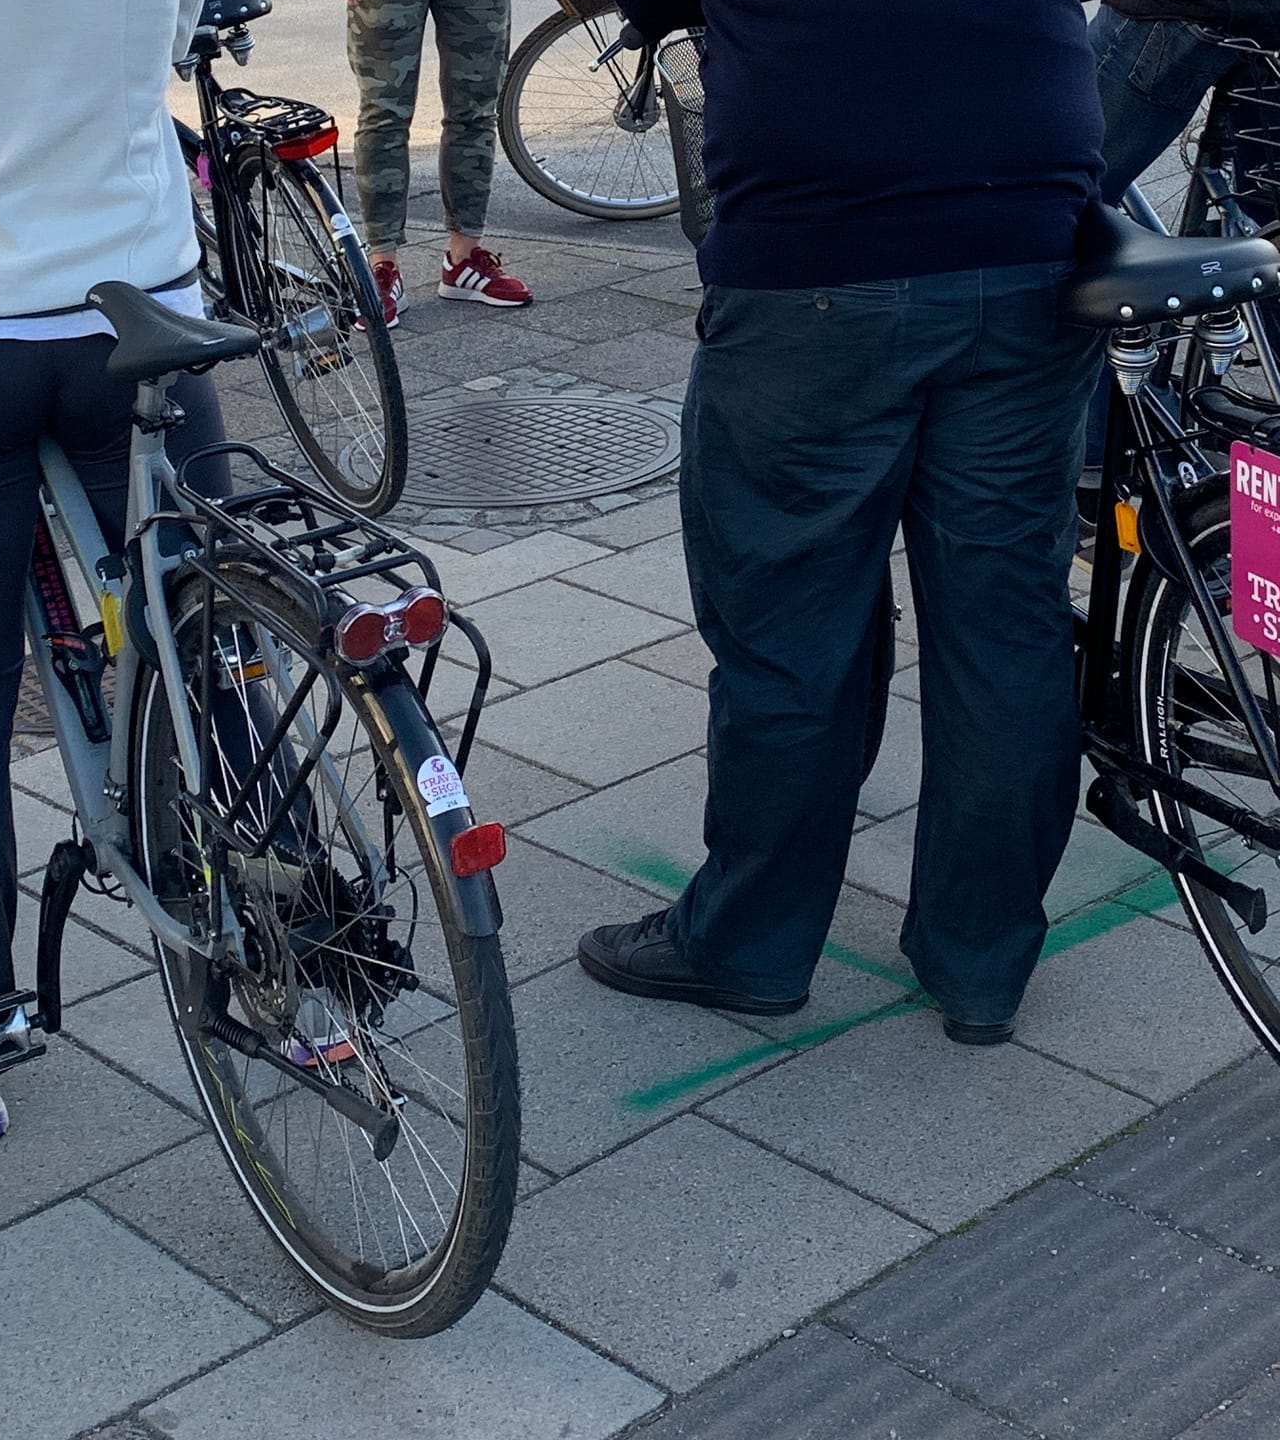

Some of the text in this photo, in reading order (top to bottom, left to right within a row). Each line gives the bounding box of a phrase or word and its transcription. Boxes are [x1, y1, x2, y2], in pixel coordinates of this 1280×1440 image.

[1250, 500, 1262, 514] for
[1157, 695, 1170, 759] RALEIGH
[420, 771, 460, 790] TRAVEL
